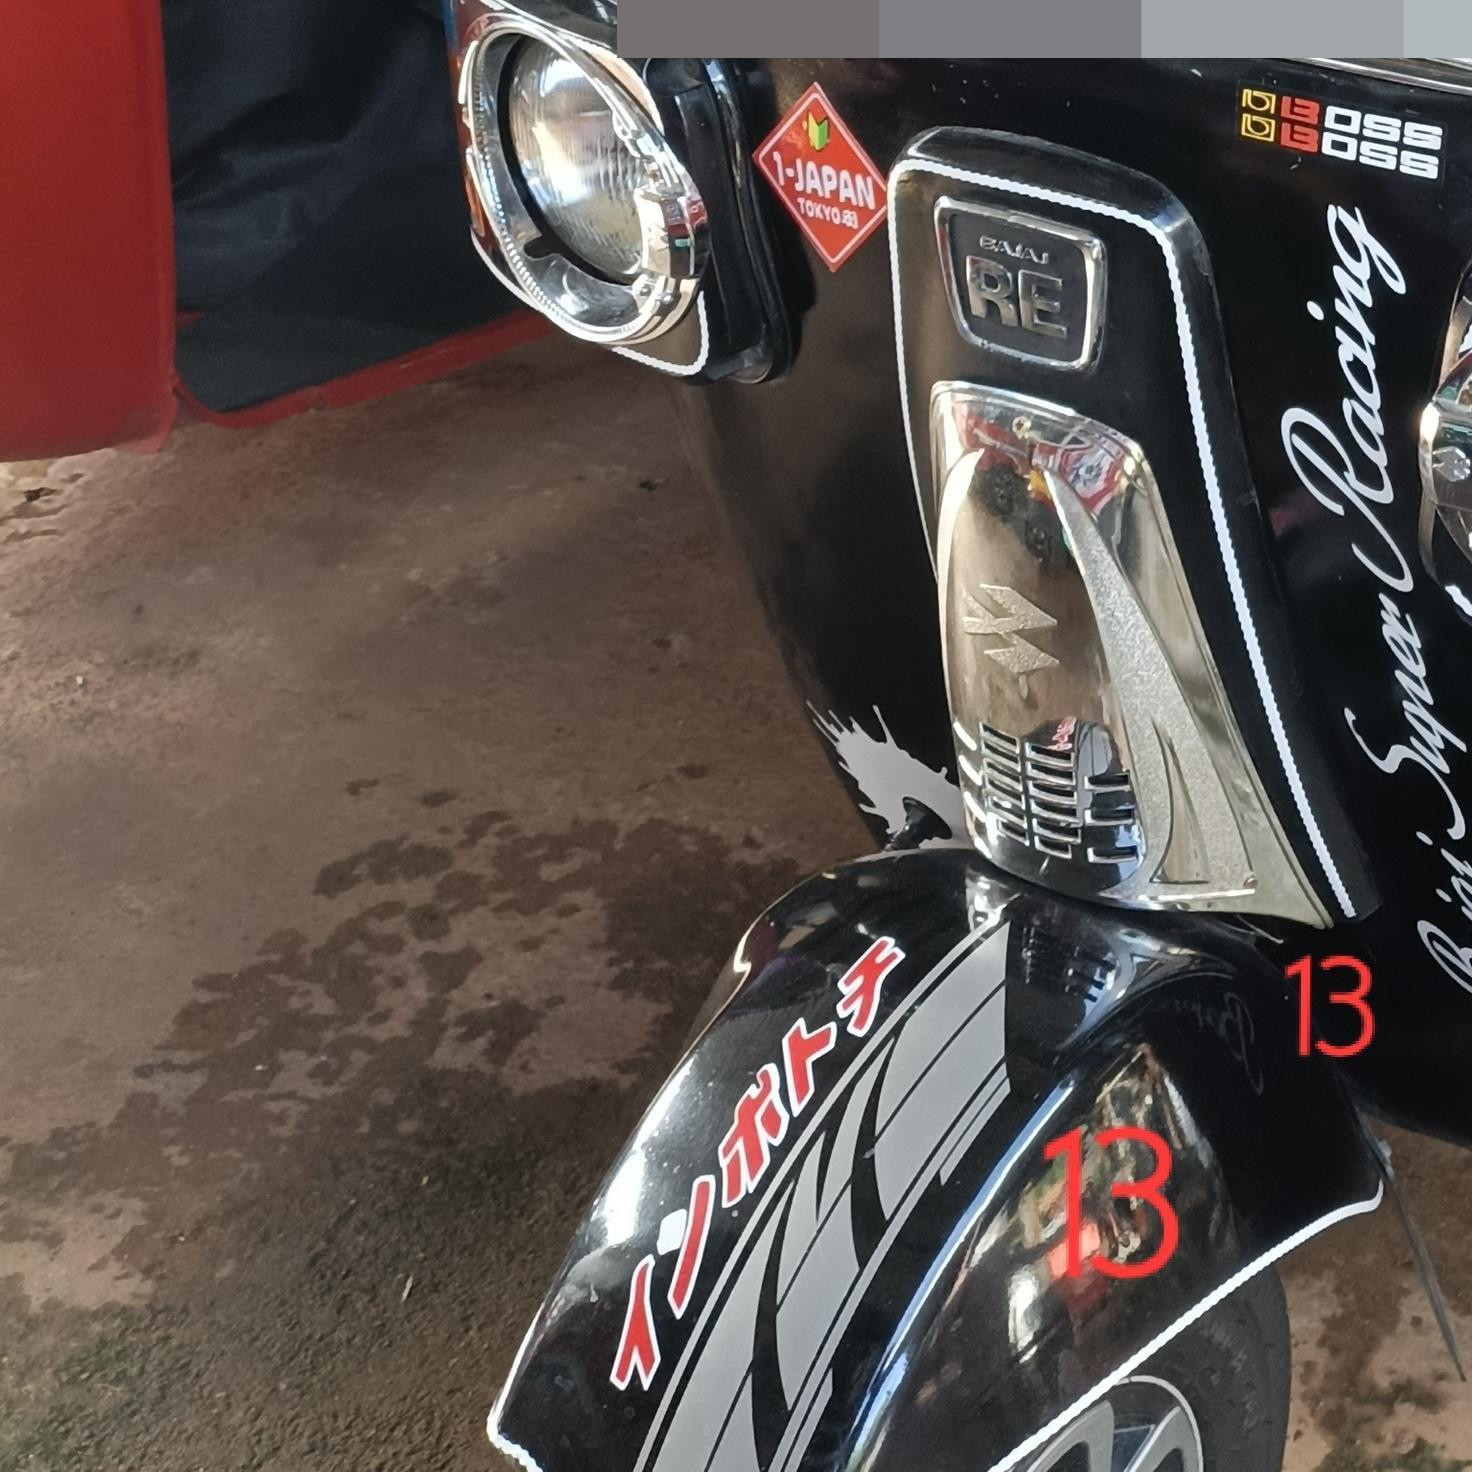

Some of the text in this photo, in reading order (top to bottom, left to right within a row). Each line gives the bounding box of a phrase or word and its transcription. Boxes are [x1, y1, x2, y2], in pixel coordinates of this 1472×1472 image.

[772, 150, 876, 210] 1-JAPAN
[965, 254, 1068, 340] RE
[1280, 203, 1414, 591] Racing
